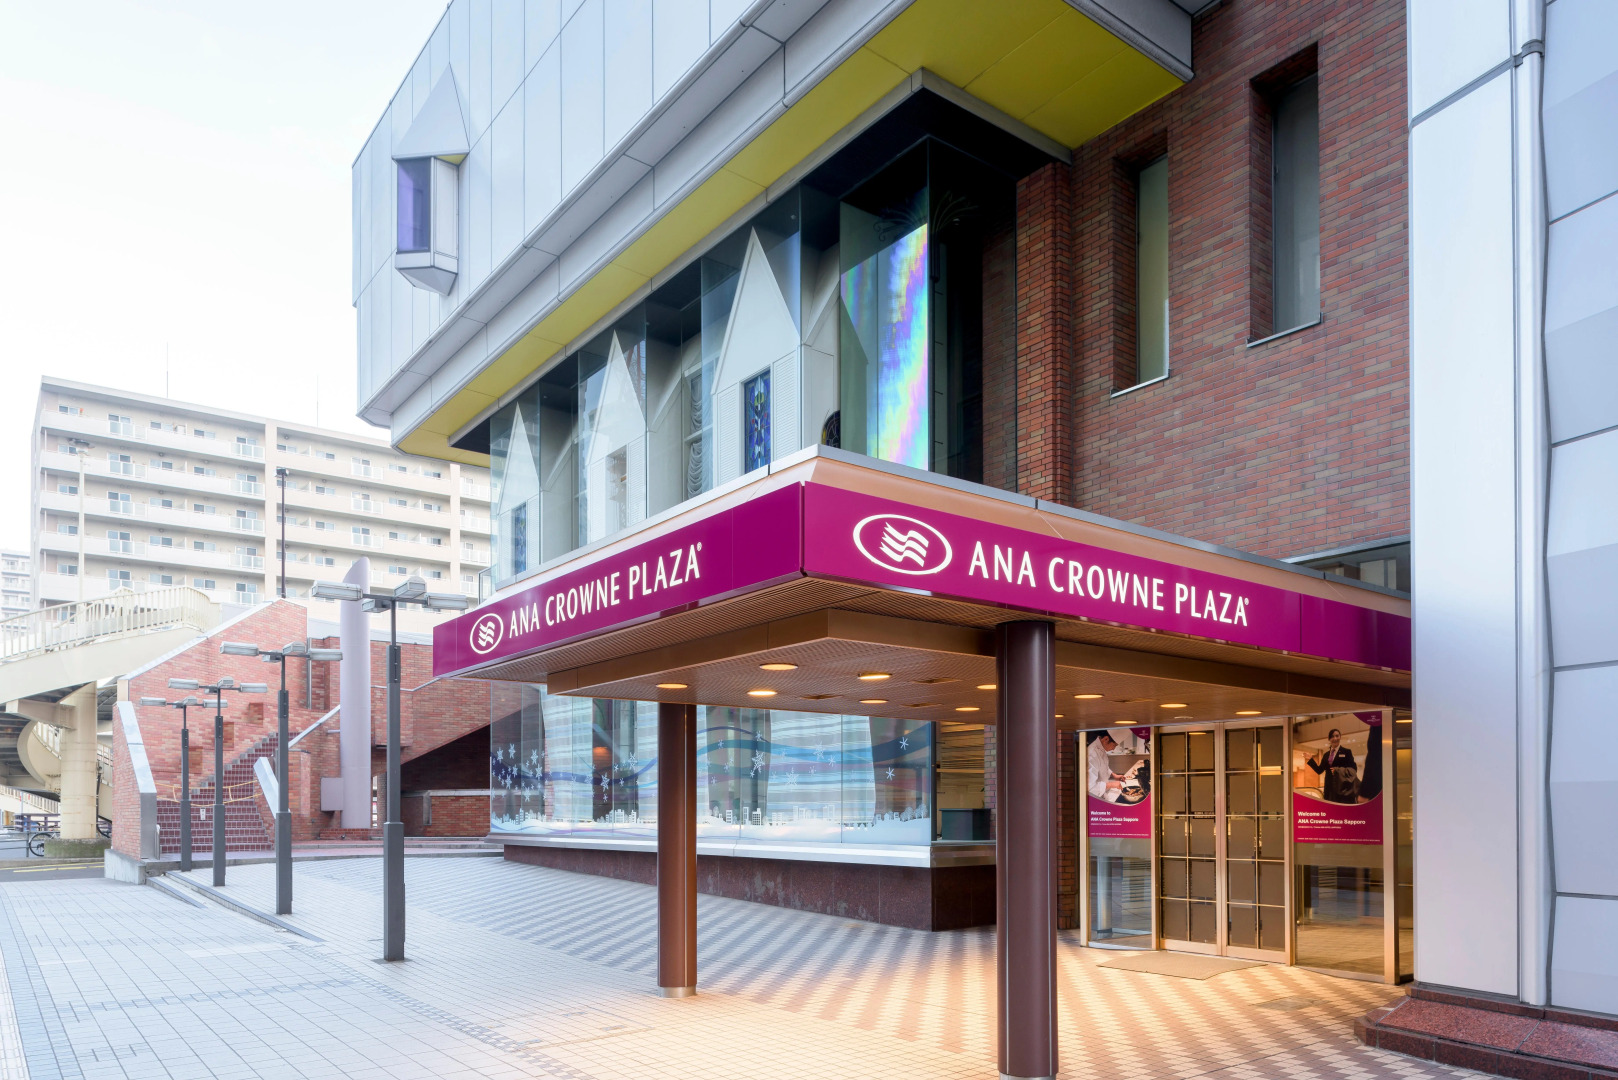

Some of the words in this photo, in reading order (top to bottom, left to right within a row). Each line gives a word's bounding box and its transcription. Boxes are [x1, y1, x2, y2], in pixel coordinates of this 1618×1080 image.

[508, 602, 540, 639] ANA
[544, 571, 621, 627] CROWNE
[968, 540, 1037, 588] ANA
[1047, 556, 1165, 612] CROWNE
